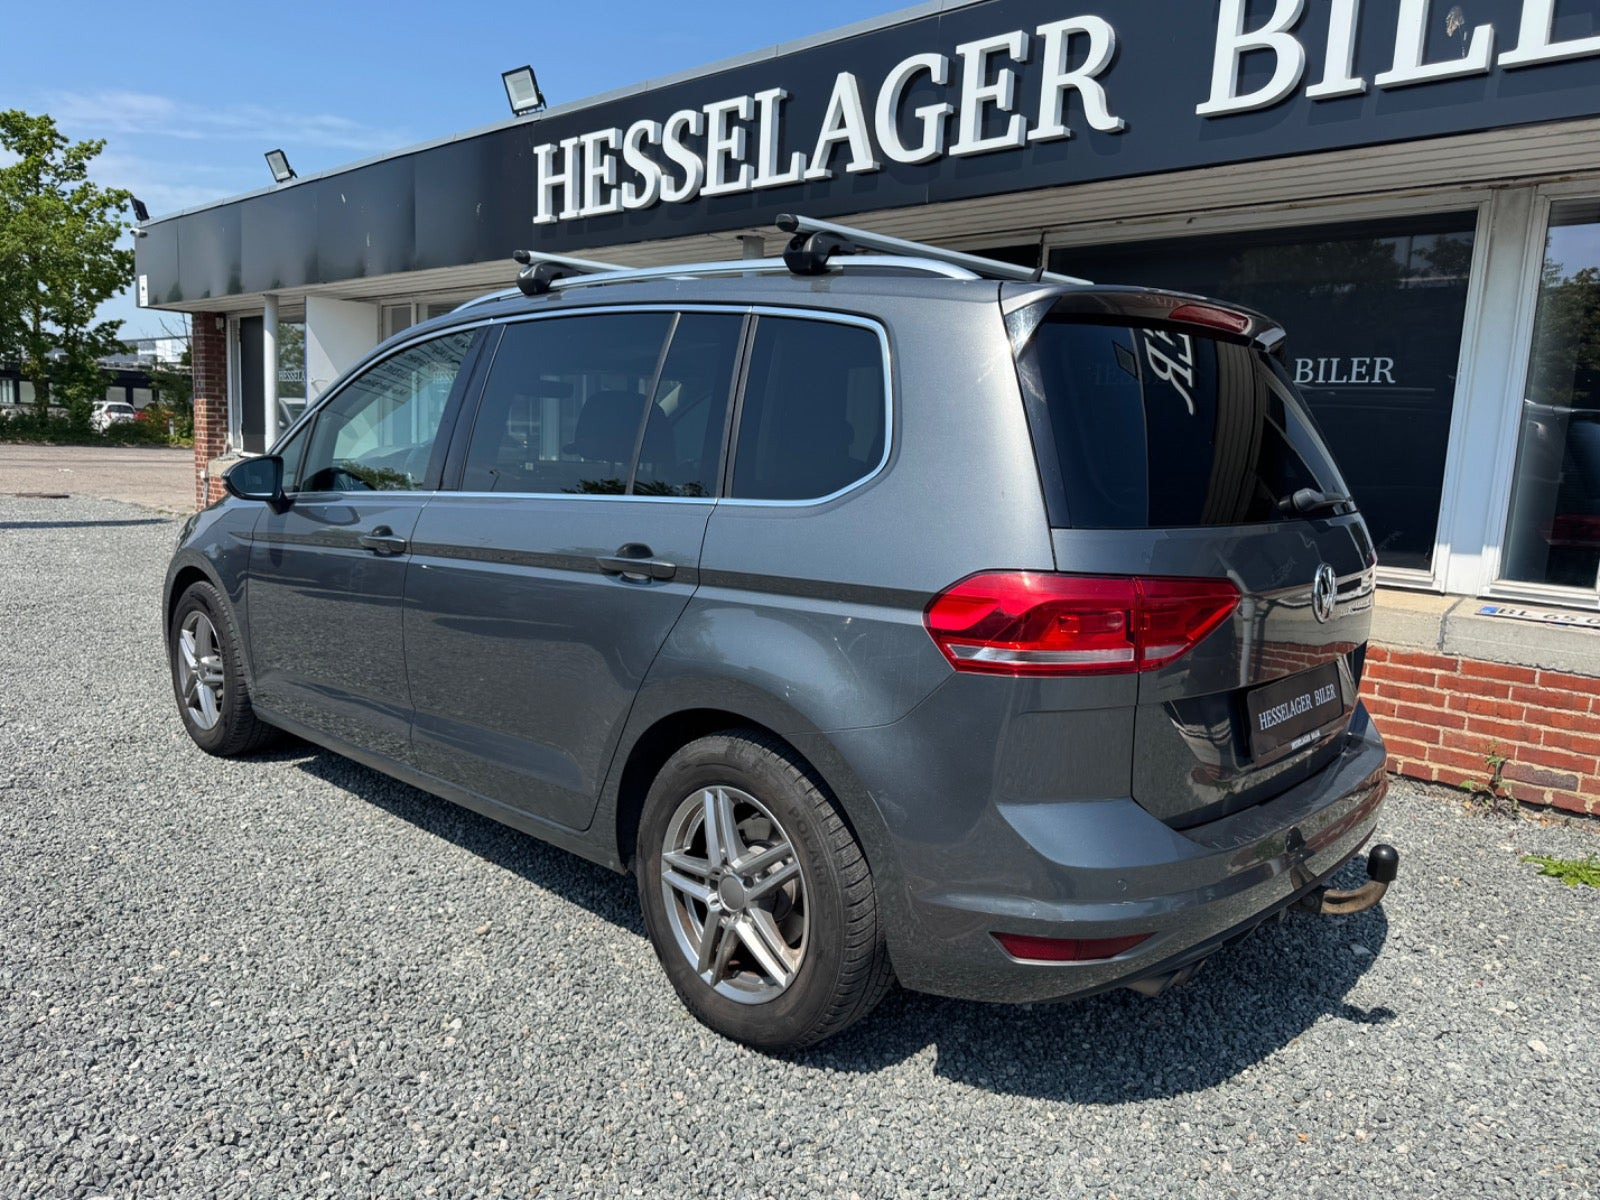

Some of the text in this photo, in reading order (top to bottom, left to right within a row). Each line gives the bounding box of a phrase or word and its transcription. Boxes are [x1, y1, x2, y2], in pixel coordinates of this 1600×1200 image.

[533, 15, 1125, 224] HESSELAGER
[1292, 356, 1396, 384] BILER
[1258, 683, 1337, 731] HESSELAGER BILER
